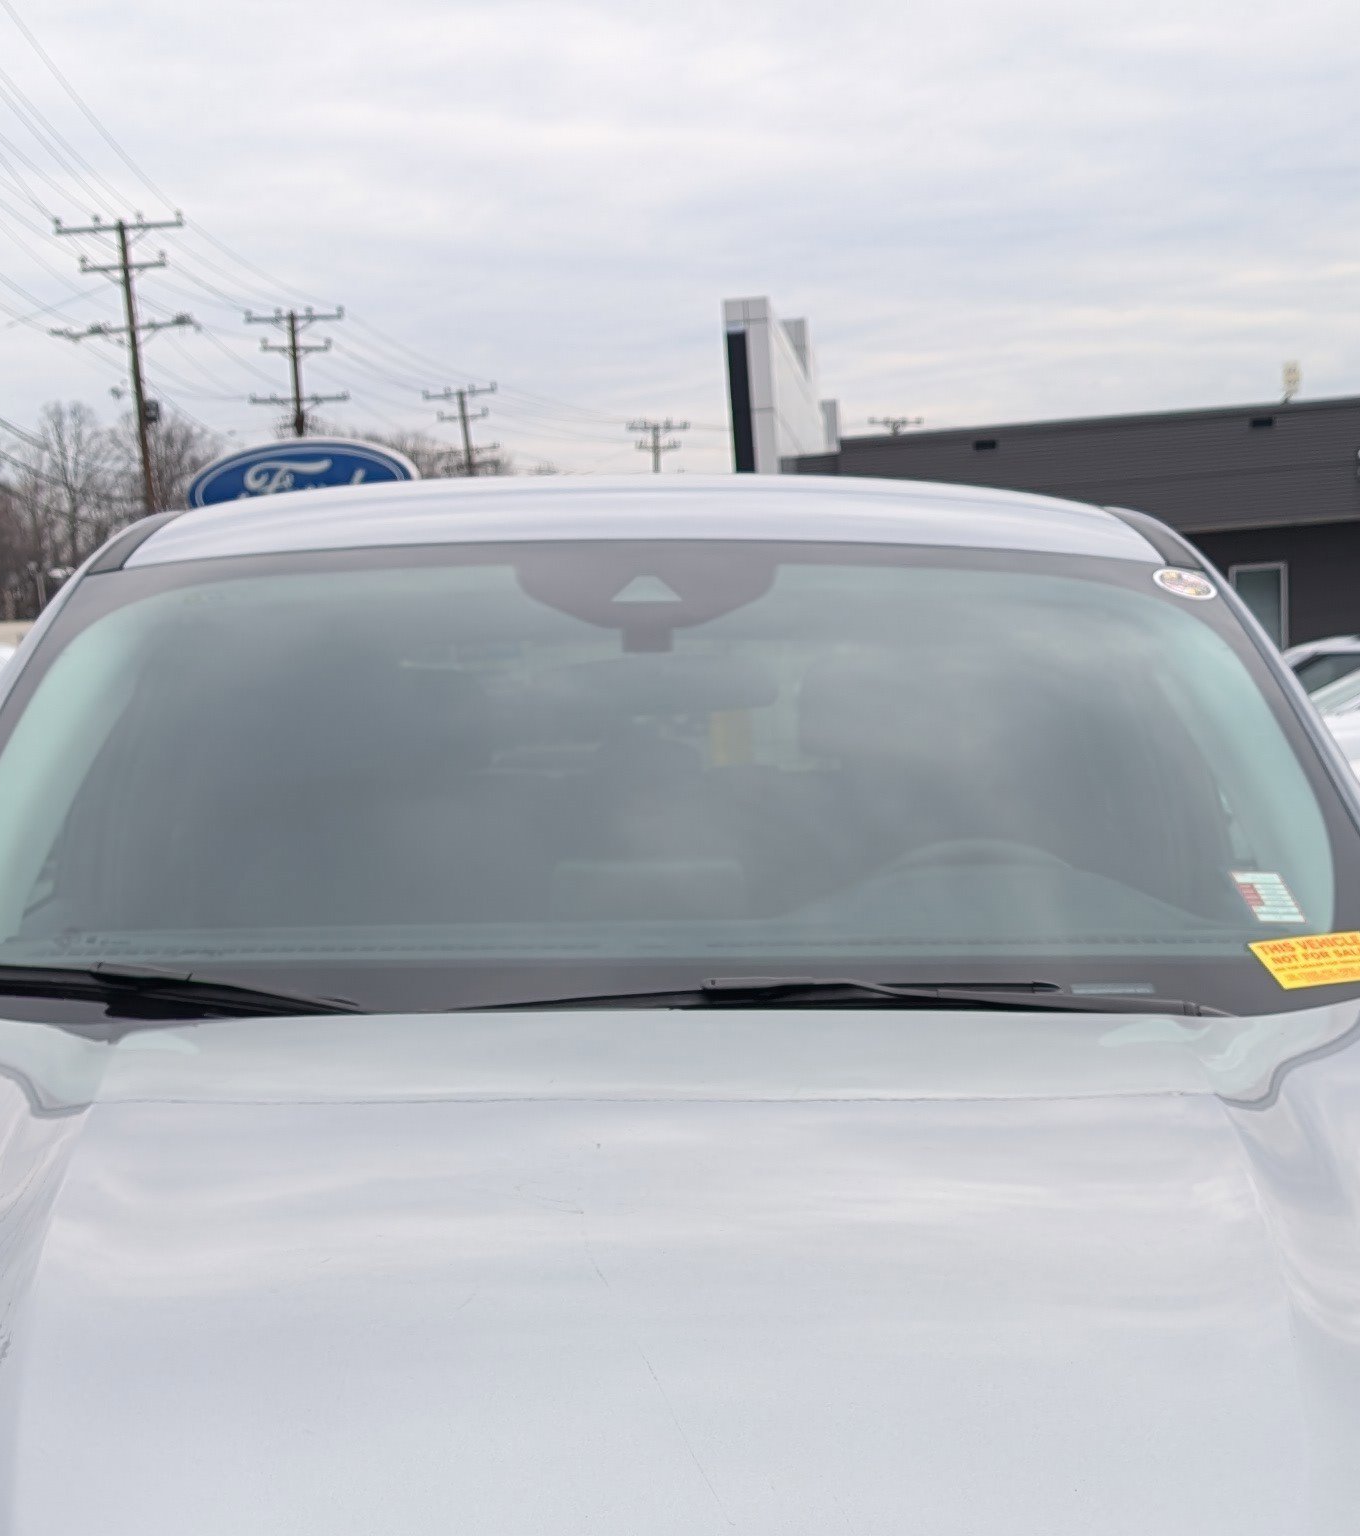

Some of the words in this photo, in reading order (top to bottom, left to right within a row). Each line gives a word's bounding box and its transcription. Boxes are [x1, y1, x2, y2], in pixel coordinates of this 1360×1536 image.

[1258, 941, 1295, 955] THIS
[1271, 953, 1298, 964] NOT
[1301, 951, 1330, 961] FOR
